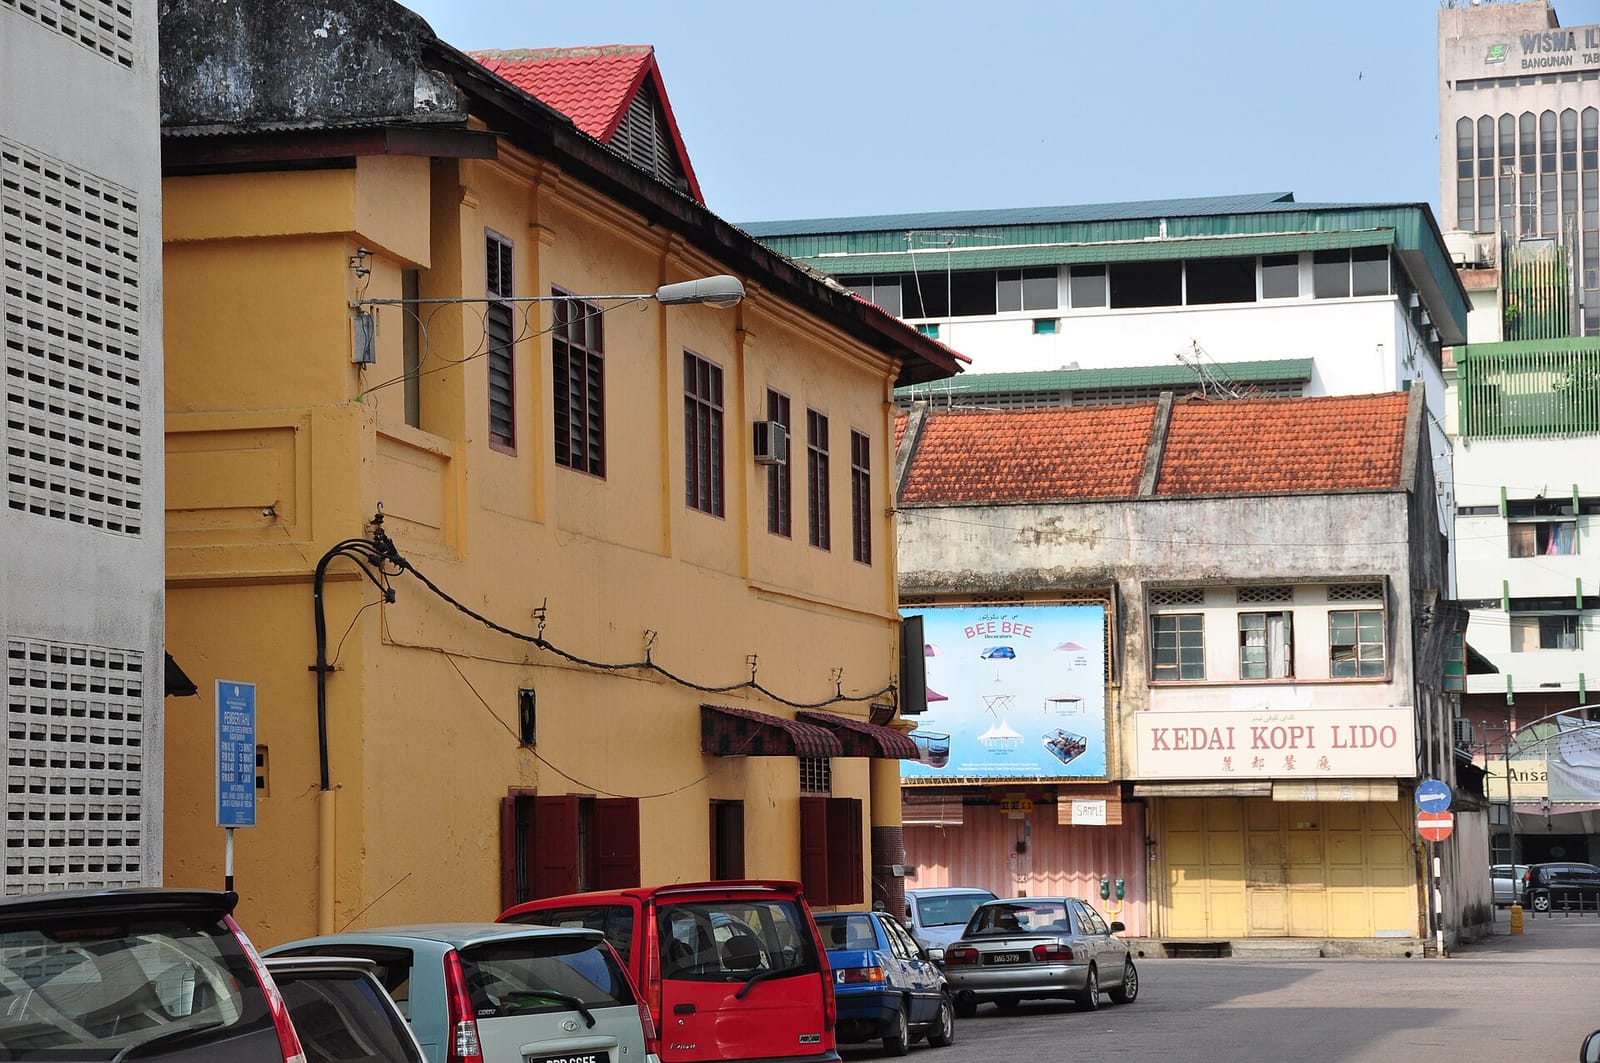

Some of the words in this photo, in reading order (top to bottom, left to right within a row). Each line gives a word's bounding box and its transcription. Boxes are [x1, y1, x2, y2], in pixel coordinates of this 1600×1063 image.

[1520, 32, 1577, 55] WISMA
[1584, 28, 1600, 49] IL
[1521, 55, 1573, 69] BANGUNAN
[964, 621, 997, 639] BEE
[1002, 621, 1034, 638] BEE
[1151, 727, 1236, 751] KEDAI
[1250, 725, 1316, 750] KOPI
[1330, 724, 1397, 749] LIDO
[1076, 804, 1104, 817] SAMPLE
